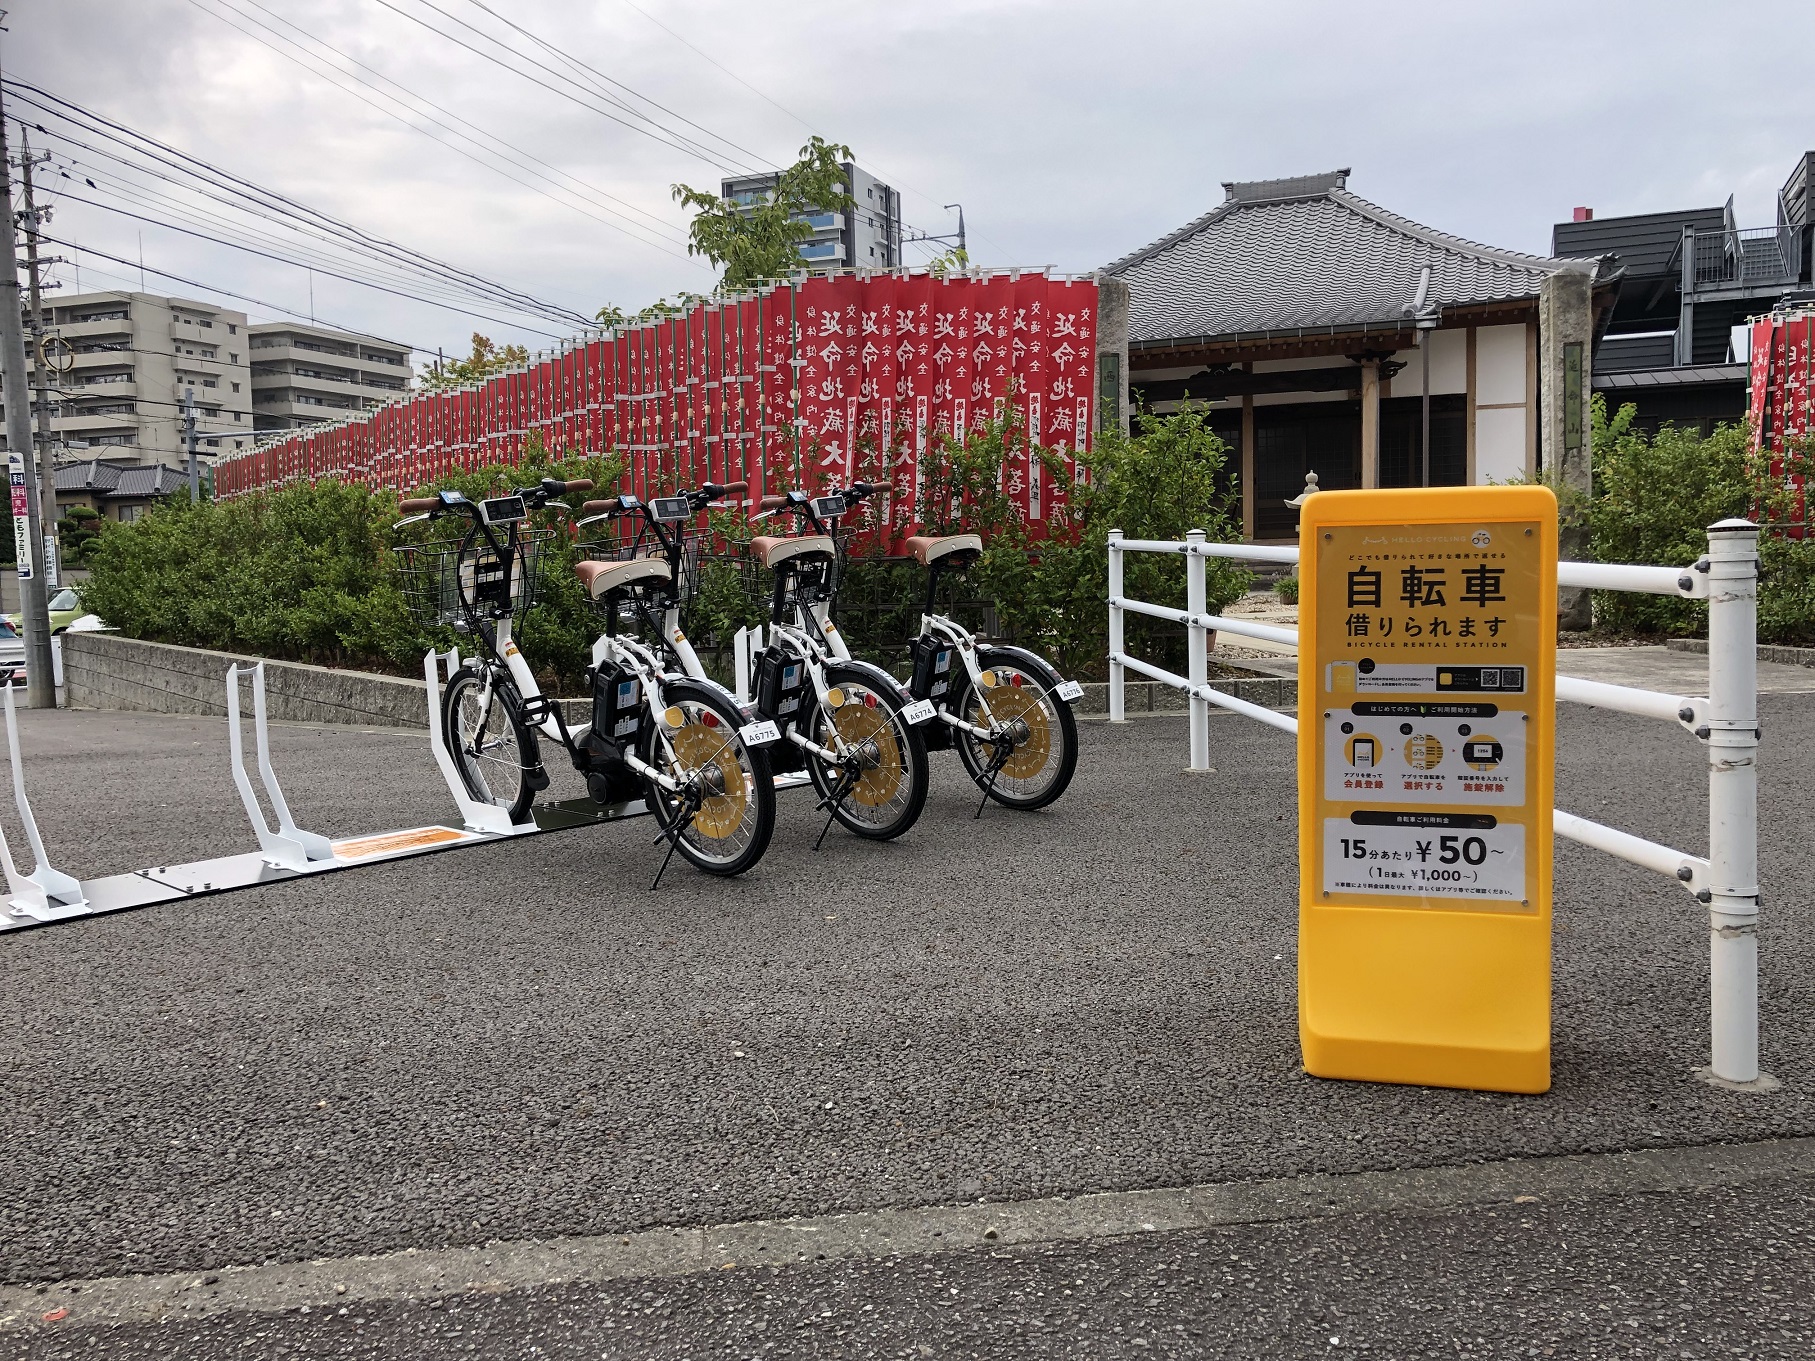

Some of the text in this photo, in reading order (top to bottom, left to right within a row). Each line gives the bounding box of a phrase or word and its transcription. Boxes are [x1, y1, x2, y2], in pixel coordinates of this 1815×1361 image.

[1347, 564, 1506, 608] 自転車
[1345, 613, 1506, 638] 借りられます
[910, 708, 932, 721] A6774
[1370, 705, 1478, 714] はじめての方へ ご利用開始方法
[749, 730, 775, 742] A6775
[1344, 779, 1384, 789] 会員登録
[1403, 781, 1443, 791] 選択する
[1396, 816, 1449, 824] 自転車ご利用料金
